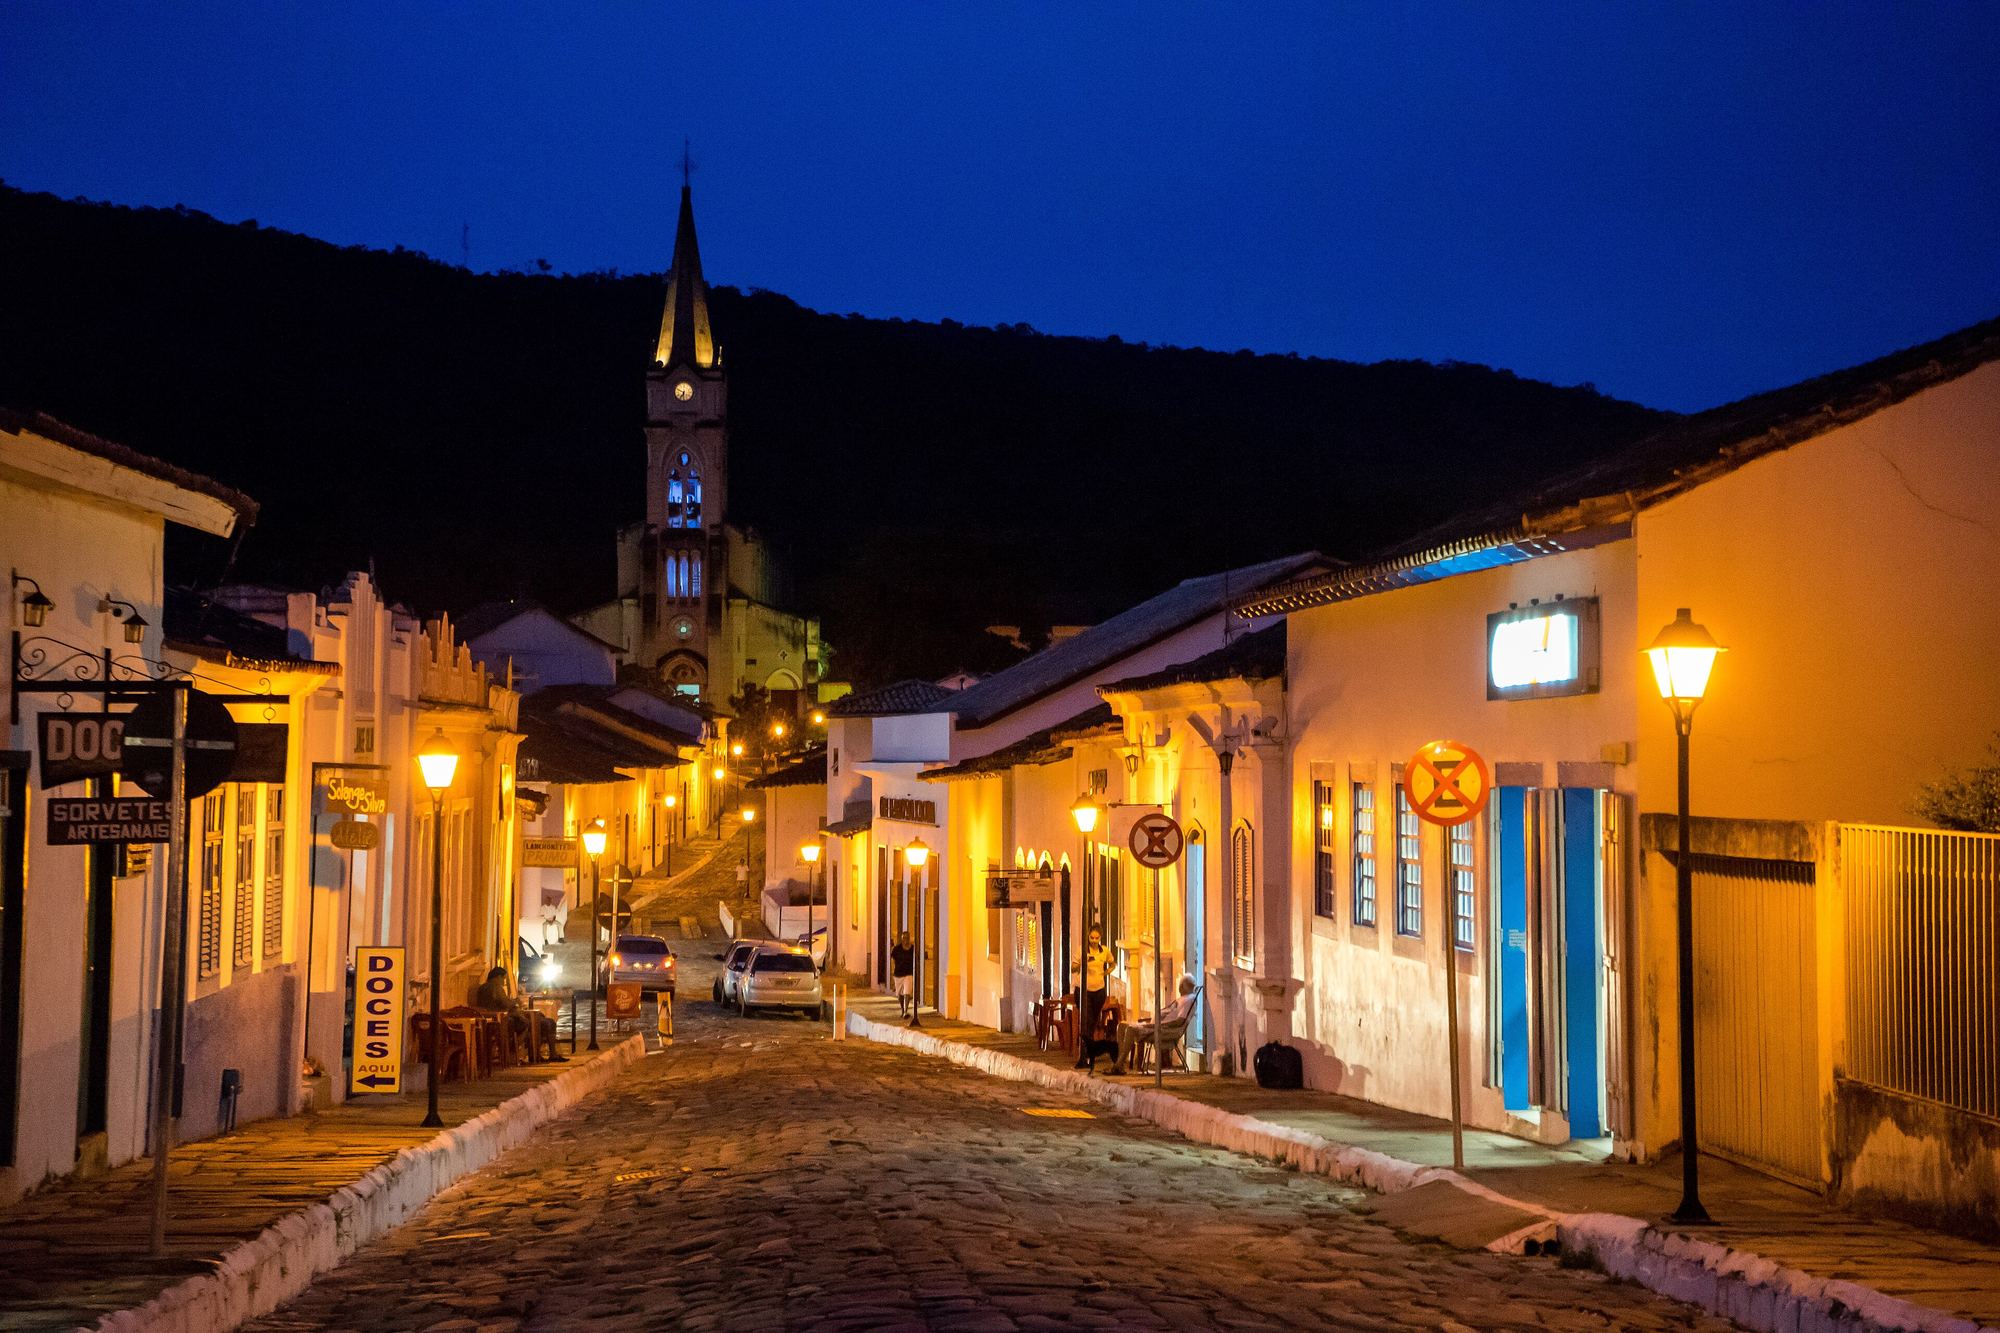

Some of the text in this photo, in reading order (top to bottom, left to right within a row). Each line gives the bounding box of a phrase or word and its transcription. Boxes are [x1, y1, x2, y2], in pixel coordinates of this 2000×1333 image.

[47, 720, 125, 761] DOC
[328, 779, 365, 809] Solange
[361, 792, 385, 813] Silva
[68, 824, 169, 840] ARTESANAIS
[527, 851, 568, 862] PRIMO
[365, 956, 393, 1059] DOCES
[358, 1065, 395, 1073] AQUI
